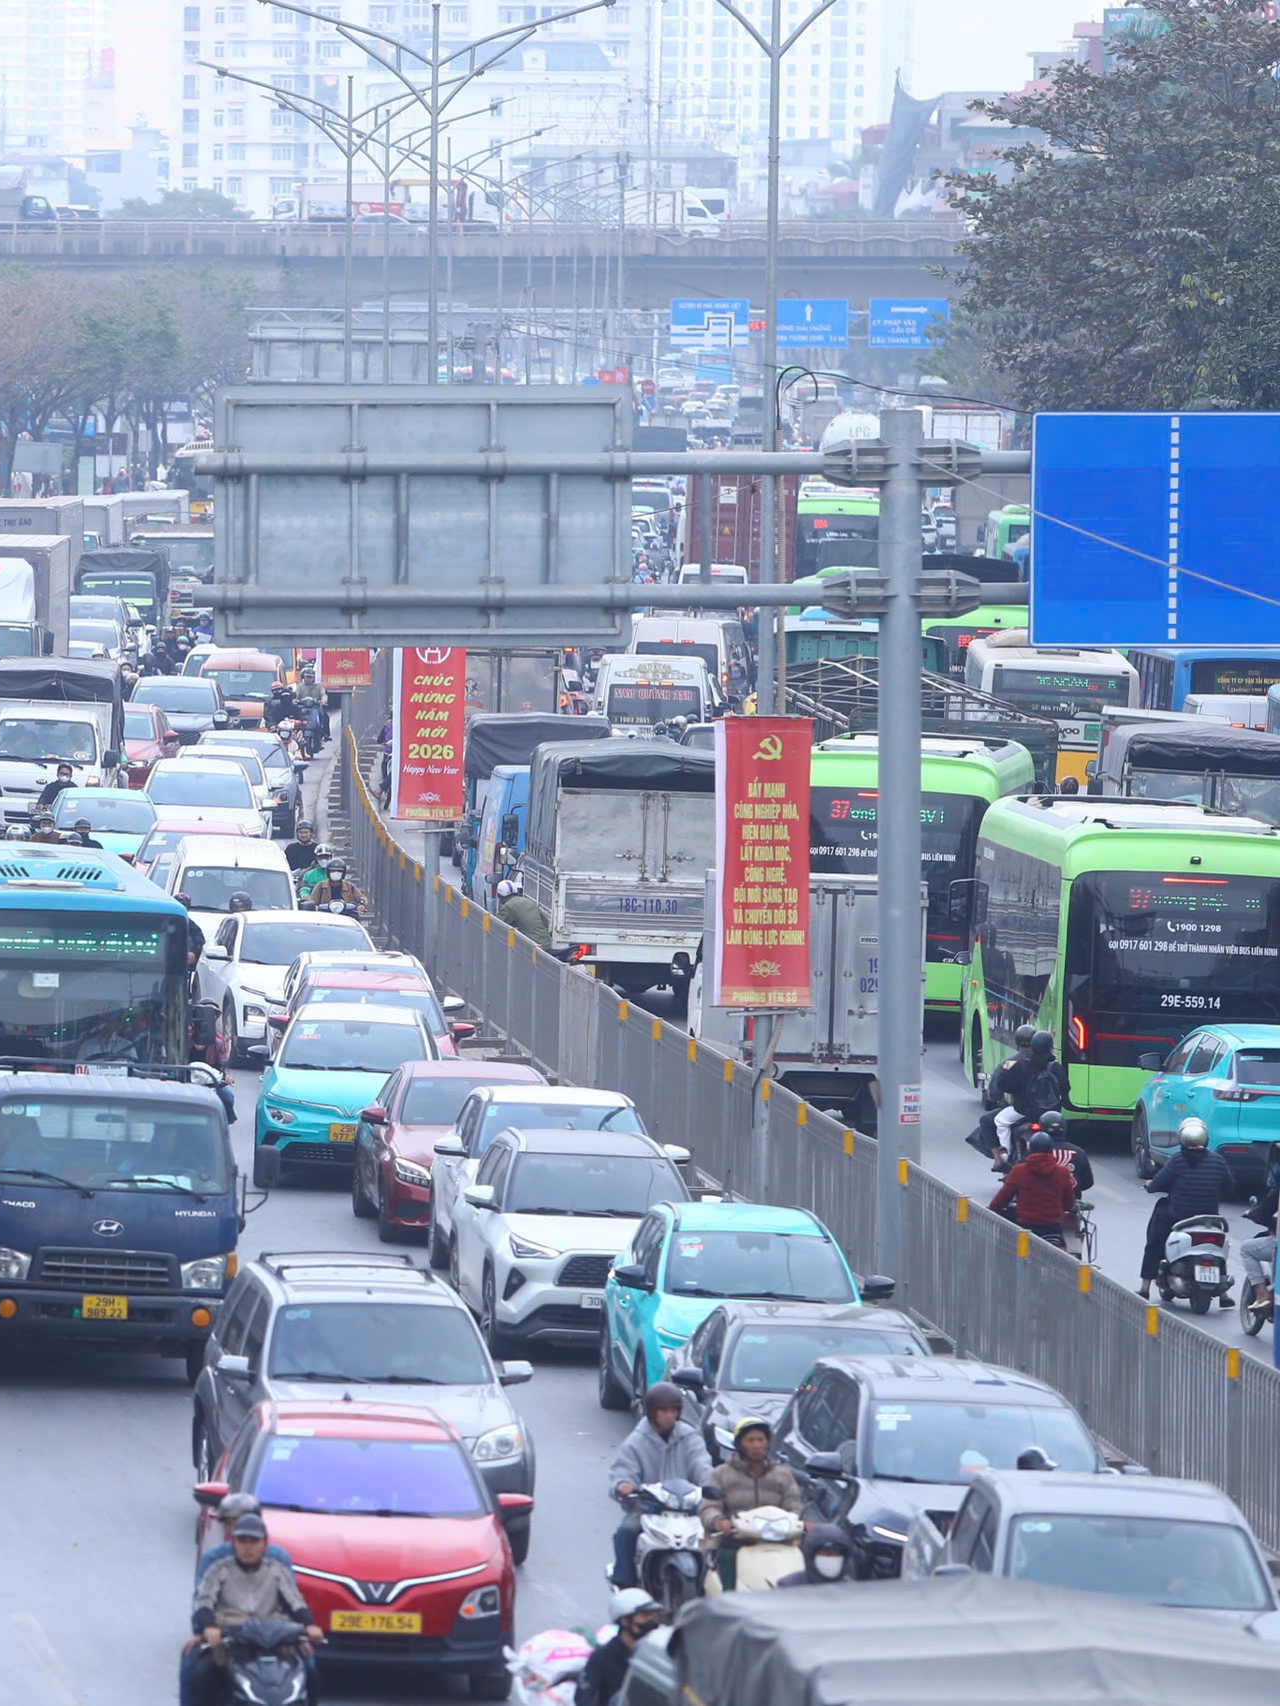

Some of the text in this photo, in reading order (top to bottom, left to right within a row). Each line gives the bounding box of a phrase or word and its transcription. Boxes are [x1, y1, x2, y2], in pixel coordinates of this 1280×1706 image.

[849, 426, 870, 437] LPG
[414, 673, 454, 686] CHÚC
[410, 691, 455, 704] MỪNG
[614, 688, 635, 699] NAM
[673, 690, 693, 700] ANH
[415, 708, 449, 721] NĂM
[416, 727, 448, 738] MỚI
[408, 744, 454, 760] 2026
[402, 764, 459, 776] Happy New Year
[748, 776, 786, 801] ĐẨY MẠNH
[734, 800, 754, 819] CÔNG
[755, 801, 781, 822] NGHIỆP
[829, 800, 851, 819] 37
[742, 822, 759, 842] HIỆN
[760, 824, 773, 843] ĐẠI
[740, 841, 754, 861] LẤY
[754, 846, 774, 861] KHOA
[810, 847, 819, 856] GỌI
[819, 846, 834, 856] 0917
[835, 847, 847, 856] 601
[848, 847, 860, 857] 298
[921, 852, 956, 862] BUS LIÊN NINH
[745, 864, 765, 882] CÔNG
[733, 883, 798, 905] ĐỔI MỚI SÁNG TẠO
[620, 897, 678, 914] 18C-110.30
[733, 903, 798, 924] VÀ CHUYỂN ĐỔI SỐ
[1175, 923, 1221, 932] 1900 1298
[726, 926, 805, 948] LÀM ĐỘNG LỰC CHÍNH!
[1108, 940, 1278, 957] GỌI 0917 601 298 ĐỂ TRỞ THÀNH NHÂN VIÊN BUS LIÊN NINH
[732, 989, 798, 1003] PHƯỜNG YÊN SỞ
[1161, 994, 1221, 1010] 29E-559.14
[2, 1200, 216, 1218] THACO HYUNDAI
[95, 1297, 116, 1307] 29H
[86, 1308, 123, 1318] 989.22
